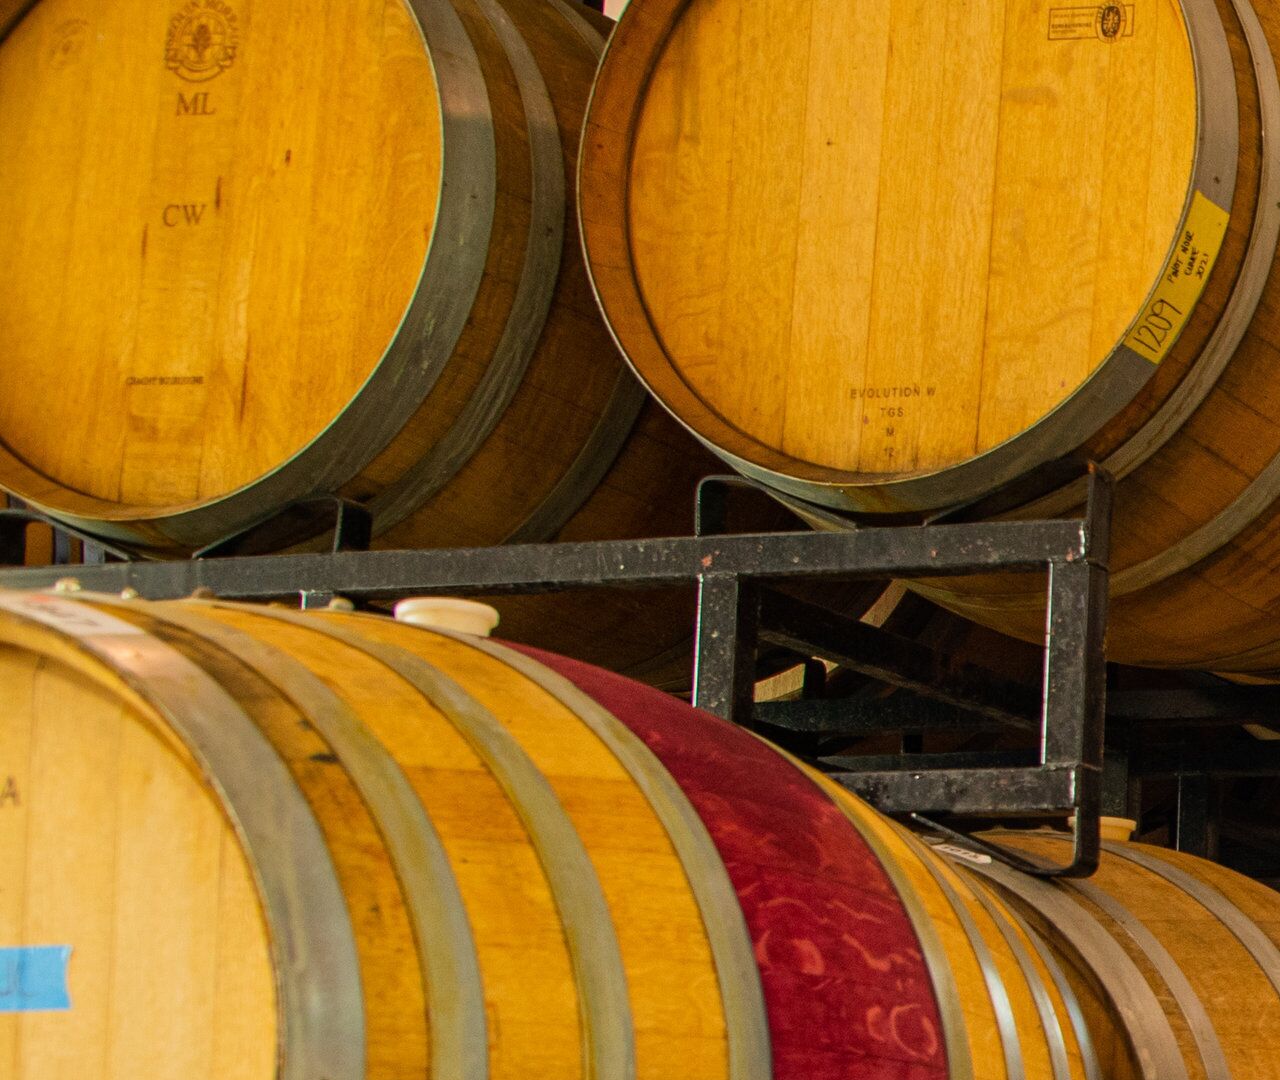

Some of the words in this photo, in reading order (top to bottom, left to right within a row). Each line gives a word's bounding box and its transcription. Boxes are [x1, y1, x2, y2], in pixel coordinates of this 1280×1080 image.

[175, 92, 217, 116] ML
[162, 203, 207, 228] CW
[1133, 299, 1182, 354] 1209
[850, 385, 921, 400] EVOLUTION
[880, 406, 905, 418] TGS
